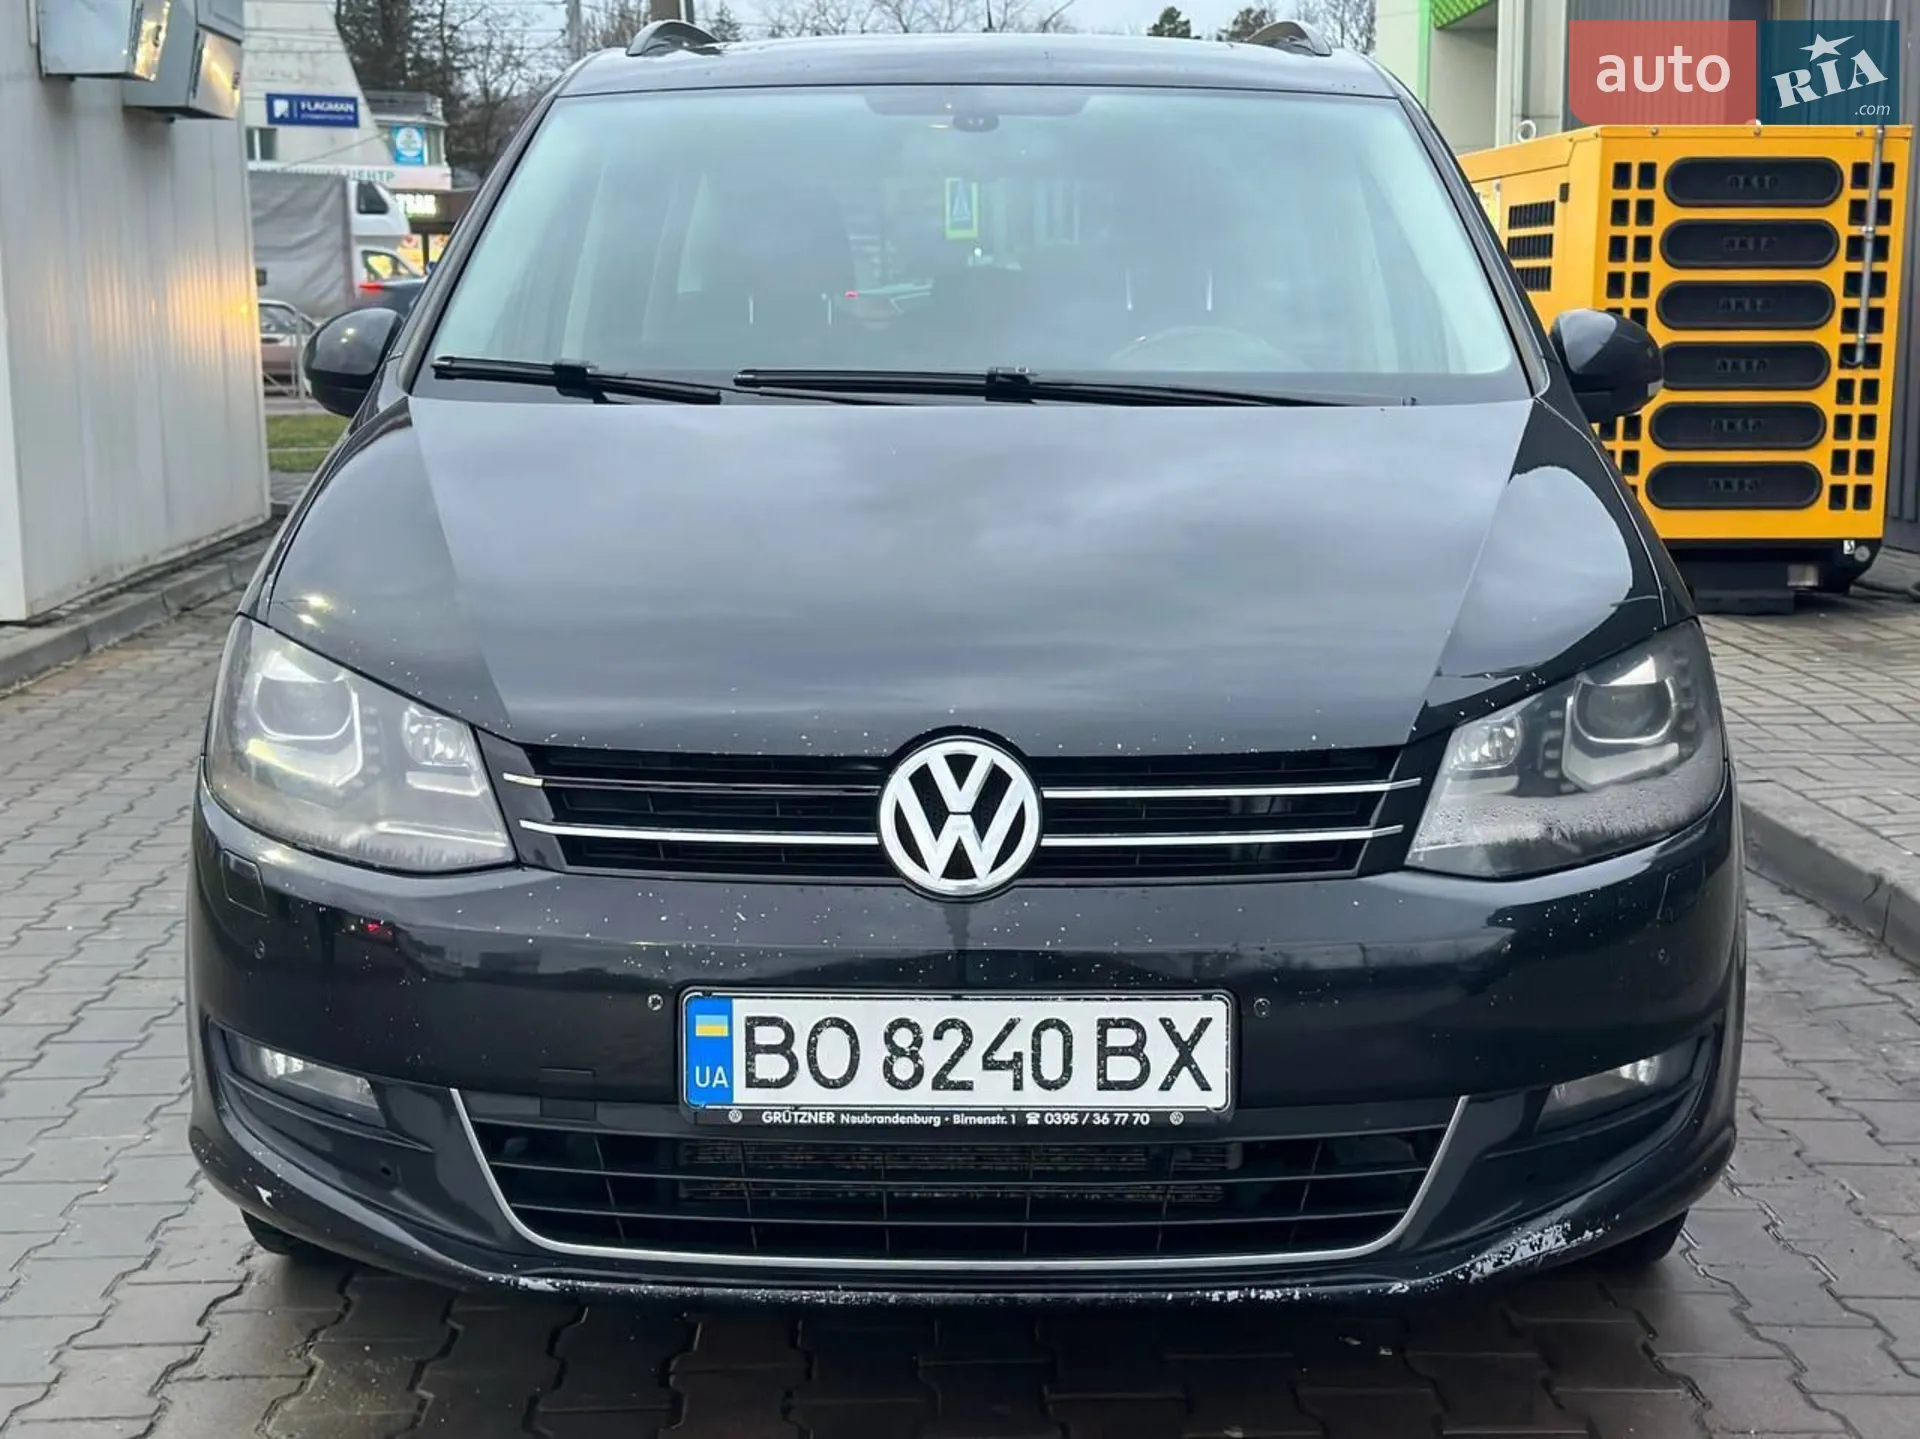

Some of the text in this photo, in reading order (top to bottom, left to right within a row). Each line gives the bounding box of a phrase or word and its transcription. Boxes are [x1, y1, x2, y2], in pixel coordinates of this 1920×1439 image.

[744, 1016, 1213, 1091] BO 8240 BX
[695, 1065, 729, 1088] UA
[761, 1110, 836, 1124] GRÜTZNER
[840, 1112, 941, 1127] Neubrandenburg
[1044, 1112, 1078, 1125] 0395
[1092, 1112, 1110, 1125] 36
[1113, 1113, 1129, 1125] 77
[1132, 1112, 1150, 1125] 70
